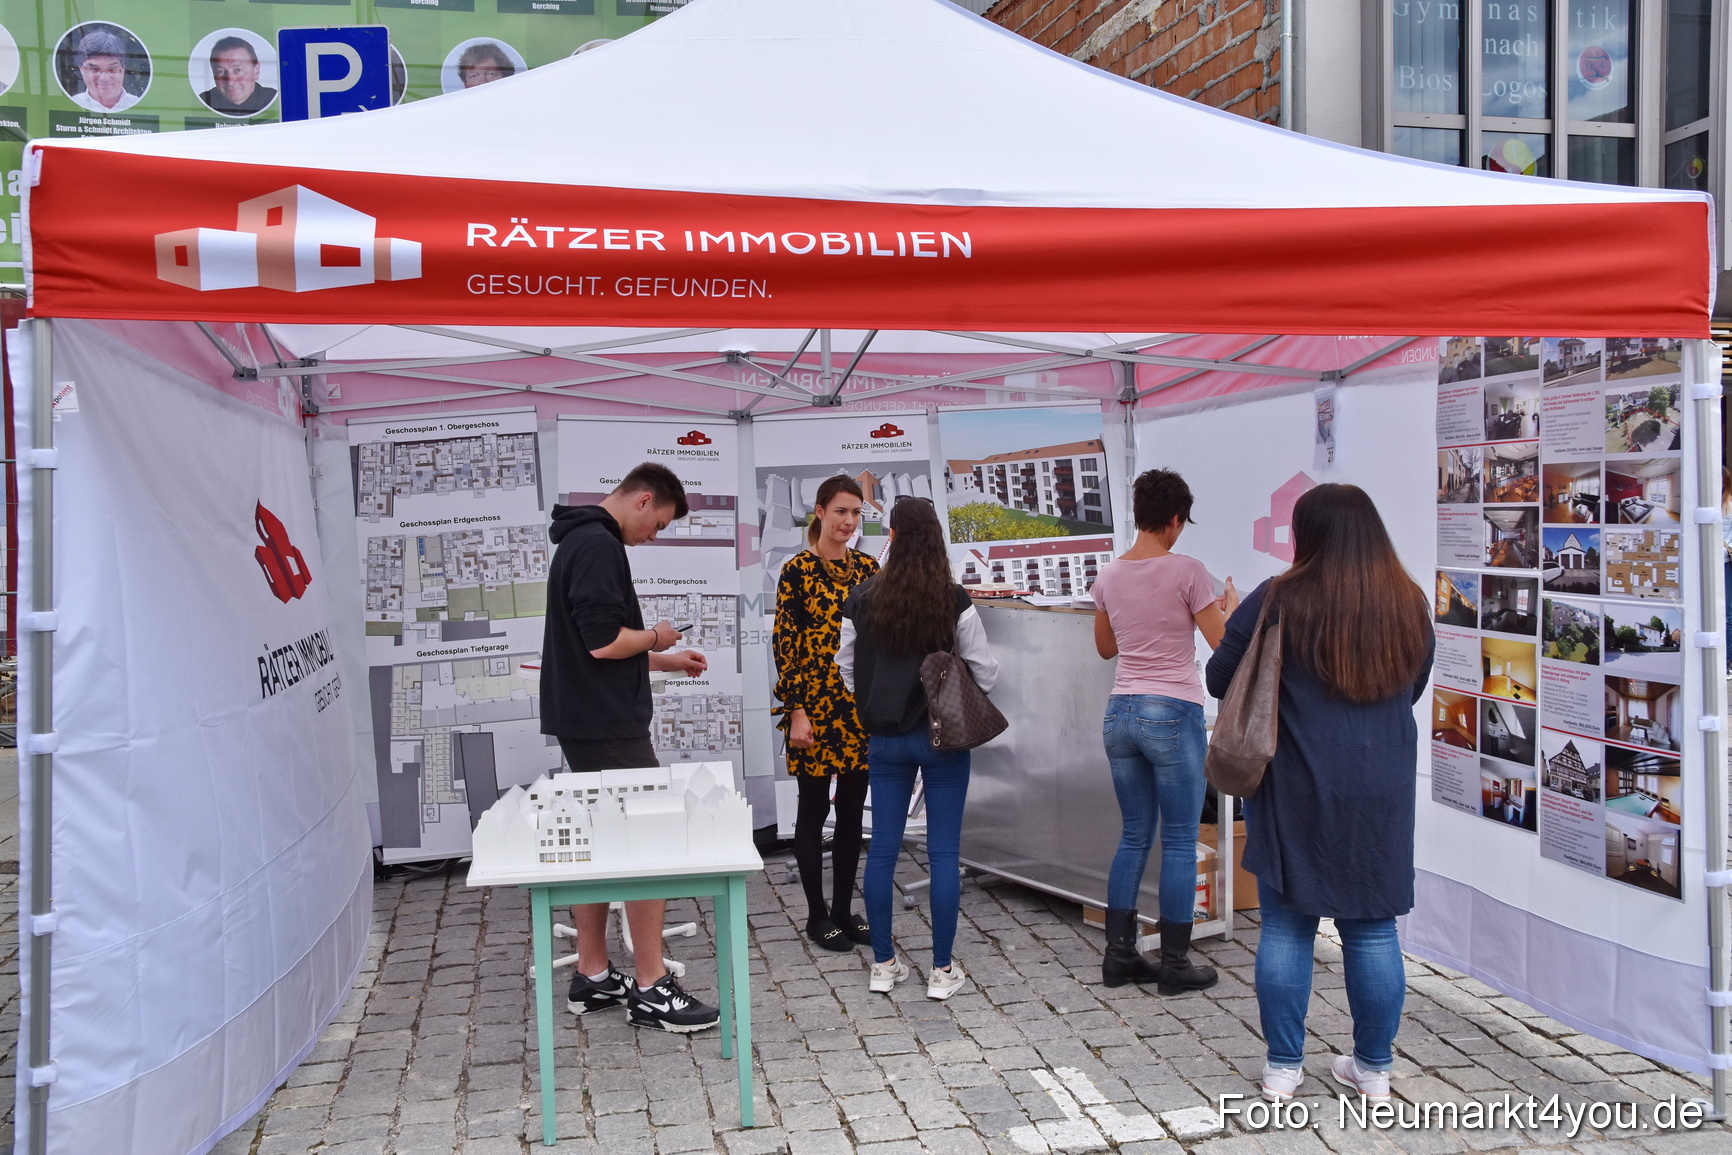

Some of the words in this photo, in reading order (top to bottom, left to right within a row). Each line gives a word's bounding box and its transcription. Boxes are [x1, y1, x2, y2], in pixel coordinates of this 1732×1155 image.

[532, 3, 560, 11] Berching
[1576, 6, 1617, 31] tik
[1483, 34, 1540, 58] nach
[305, 42, 363, 119] P
[1399, 65, 1453, 92] Bios
[0, 121, 21, 129] ekten,
[79, 116, 102, 126] Jürgen
[103, 118, 131, 127] Schmidt
[56, 125, 76, 133] Sturm
[84, 126, 112, 135] Schmidt
[467, 217, 666, 251] RÄTZER
[685, 230, 972, 259] IMMOBILIEN
[467, 273, 605, 297] GESUCHT.
[616, 276, 773, 300] GEFUNDEN.
[385, 424, 438, 436] Geschossplan
[440, 423, 446, 433] 1.
[447, 420, 500, 433] Obergeschoss
[647, 448, 675, 457] RÄTZER
[676, 450, 720, 458] IMMOBILIEN
[841, 442, 870, 450] RÄTZER
[871, 441, 912, 450] IMMOBILIEN
[400, 518, 451, 531] Geschossplan
[453, 514, 501, 526] Erdgeschoss
[632, 577, 650, 586] plan
[650, 577, 656, 586] 3.
[657, 577, 707, 587] Obergeschoss
[416, 646, 468, 658] Geschossplan
[470, 643, 509, 654] Tiefgarage
[258, 643, 304, 699] RÄTZER
[664, 678, 710, 688] bergeschoss
